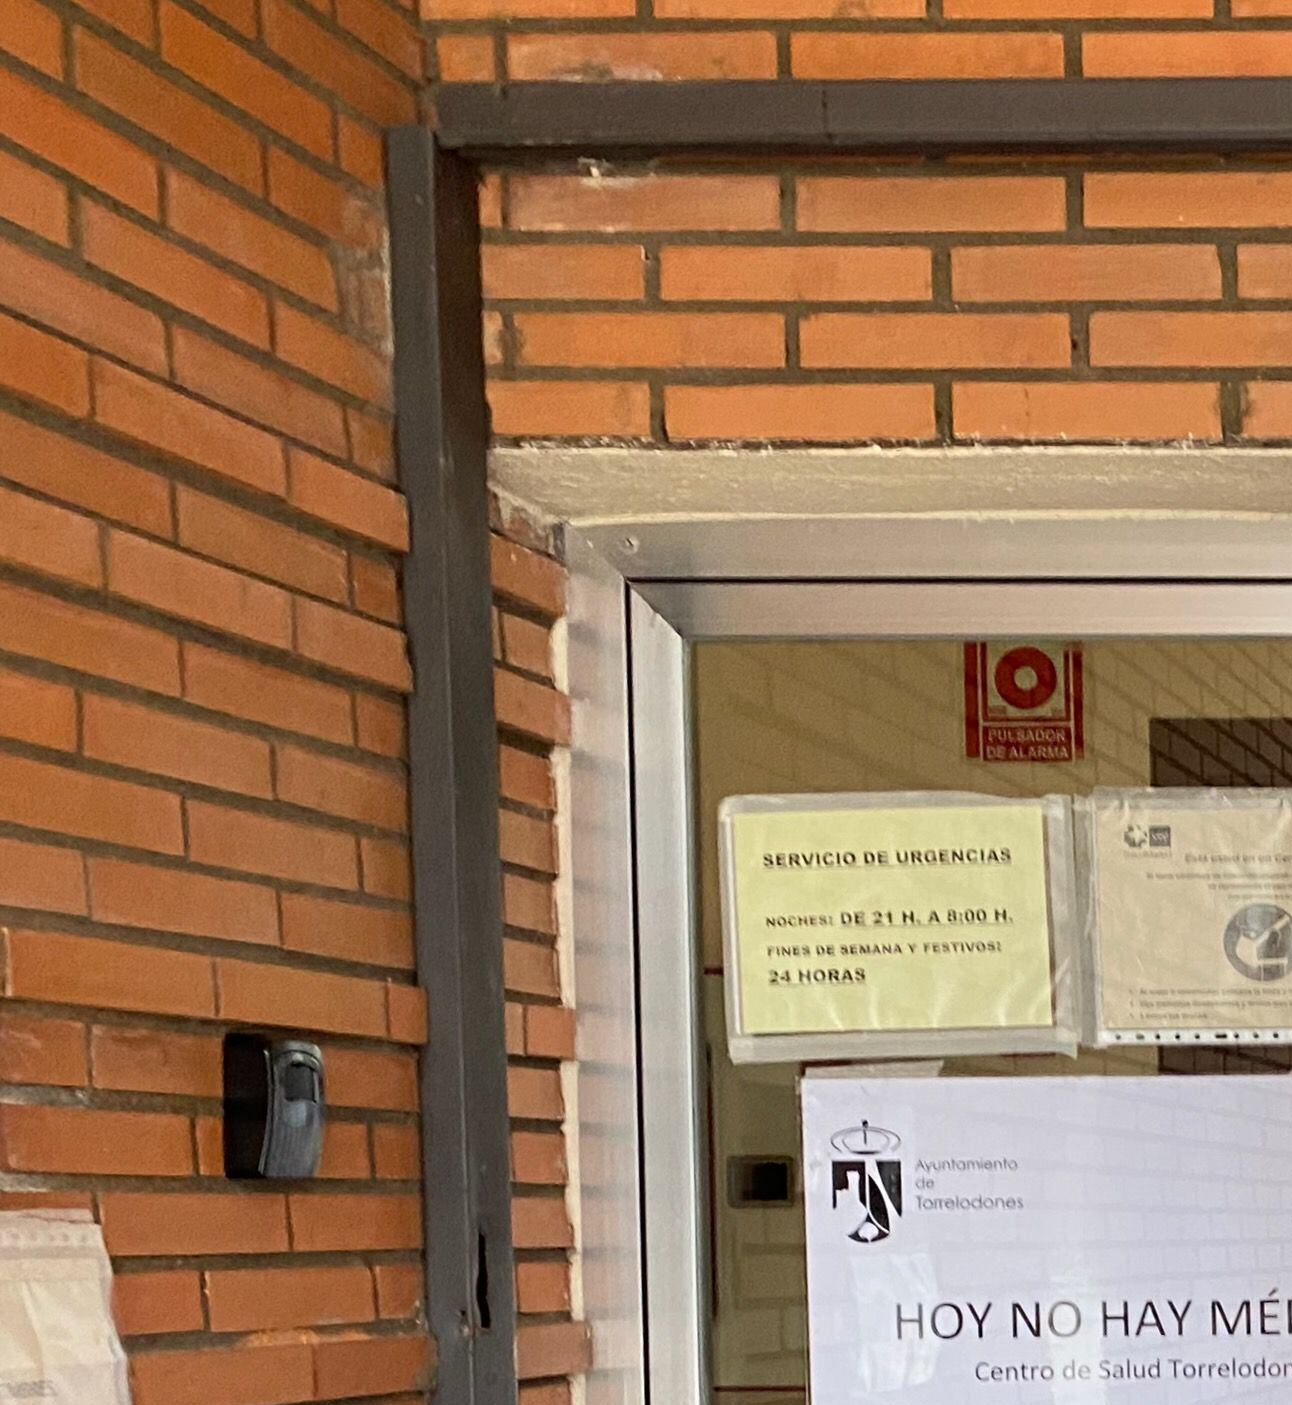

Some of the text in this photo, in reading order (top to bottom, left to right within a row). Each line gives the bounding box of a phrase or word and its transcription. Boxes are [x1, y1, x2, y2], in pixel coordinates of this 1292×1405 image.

[987, 728, 1066, 742] PULSADOR
[985, 745, 1070, 759] DE ALARMA
[763, 847, 1012, 868] SERVICIO DE URGENCIAS
[766, 908, 1013, 928] NOCHES: DE 21 H. A 8:00 H.
[767, 940, 1003, 958] FINES DE SEMANA Y FESTIVOS:
[768, 967, 867, 985] 24 HORAS
[914, 1157, 1019, 1173] Ayuntamiento
[915, 1176, 935, 1189] de
[915, 1194, 1024, 1209] Torrelodones
[895, 1301, 993, 1340] HOY
[1011, 1300, 1083, 1339] NO
[1101, 1298, 1194, 1337] HAY
[975, 1360, 1055, 1382] Centro
[1061, 1357, 1093, 1381] de
[1098, 1358, 1162, 1380] Salud
